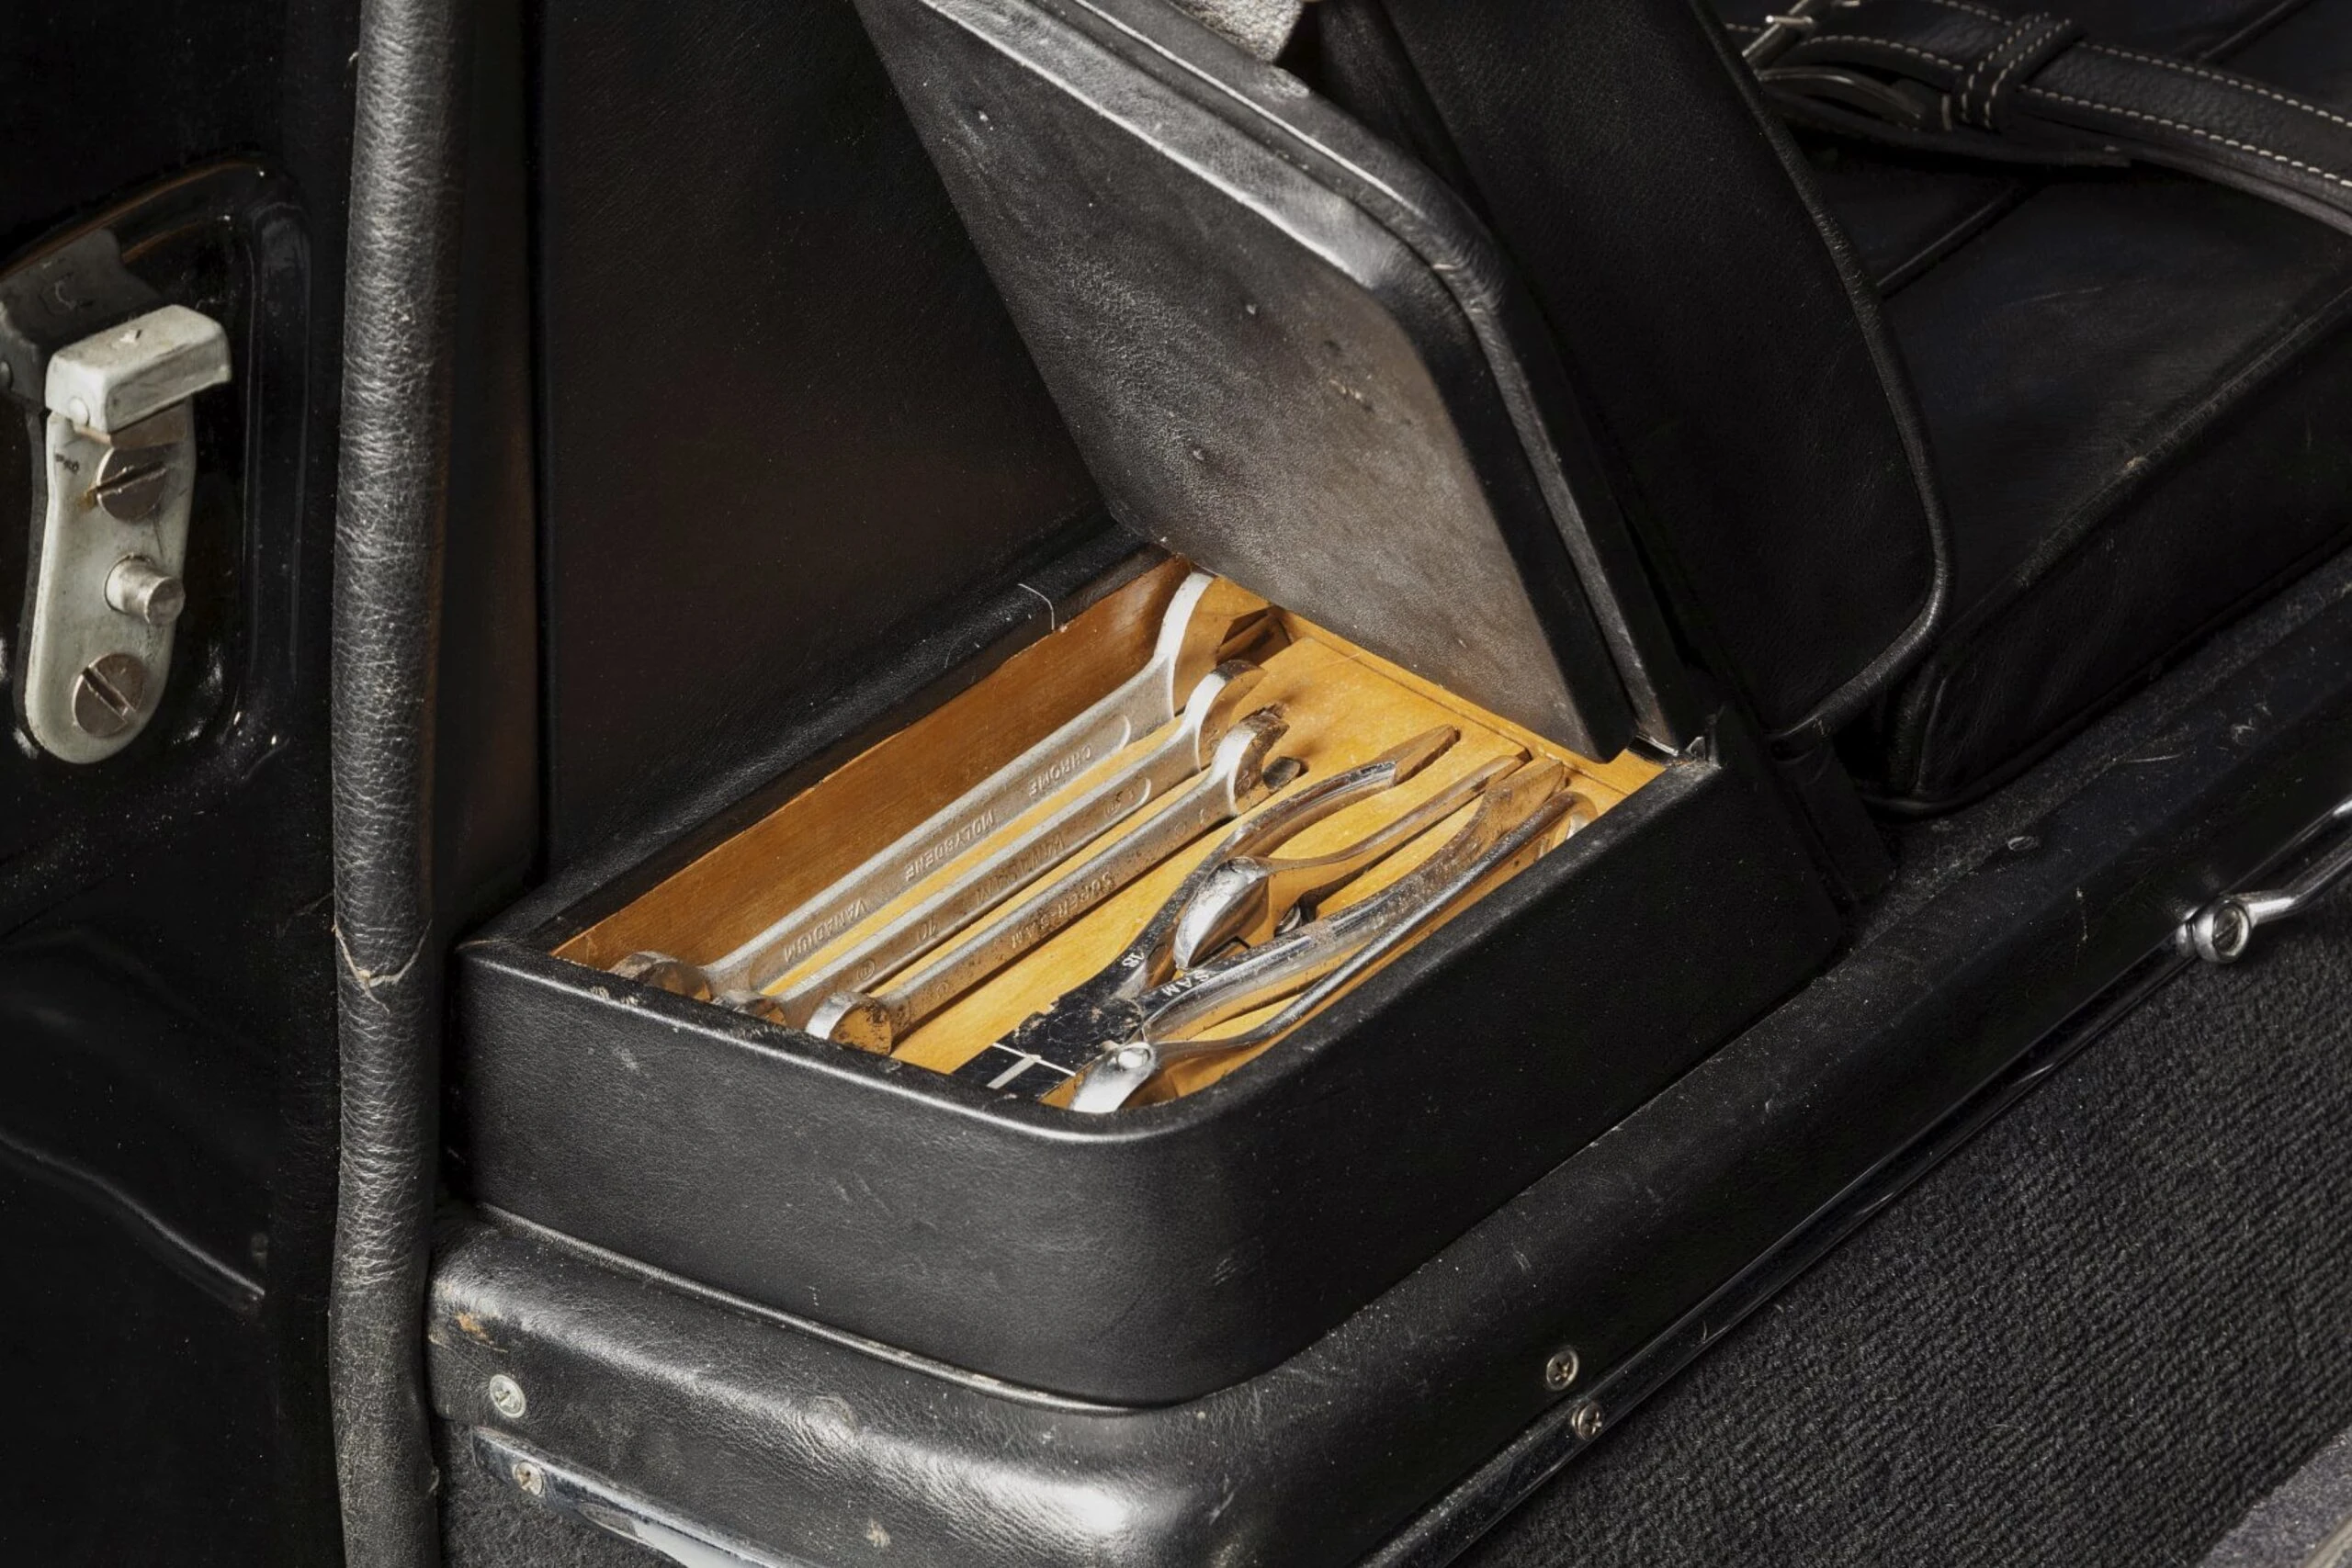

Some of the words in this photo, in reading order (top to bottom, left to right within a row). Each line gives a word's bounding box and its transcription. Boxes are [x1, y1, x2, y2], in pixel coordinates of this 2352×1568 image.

[1027, 742, 1091, 798] CHROME
[902, 807, 995, 883] MOLYBDENE
[783, 898, 868, 964] VANADIUM
[1161, 969, 1209, 997] SAM
